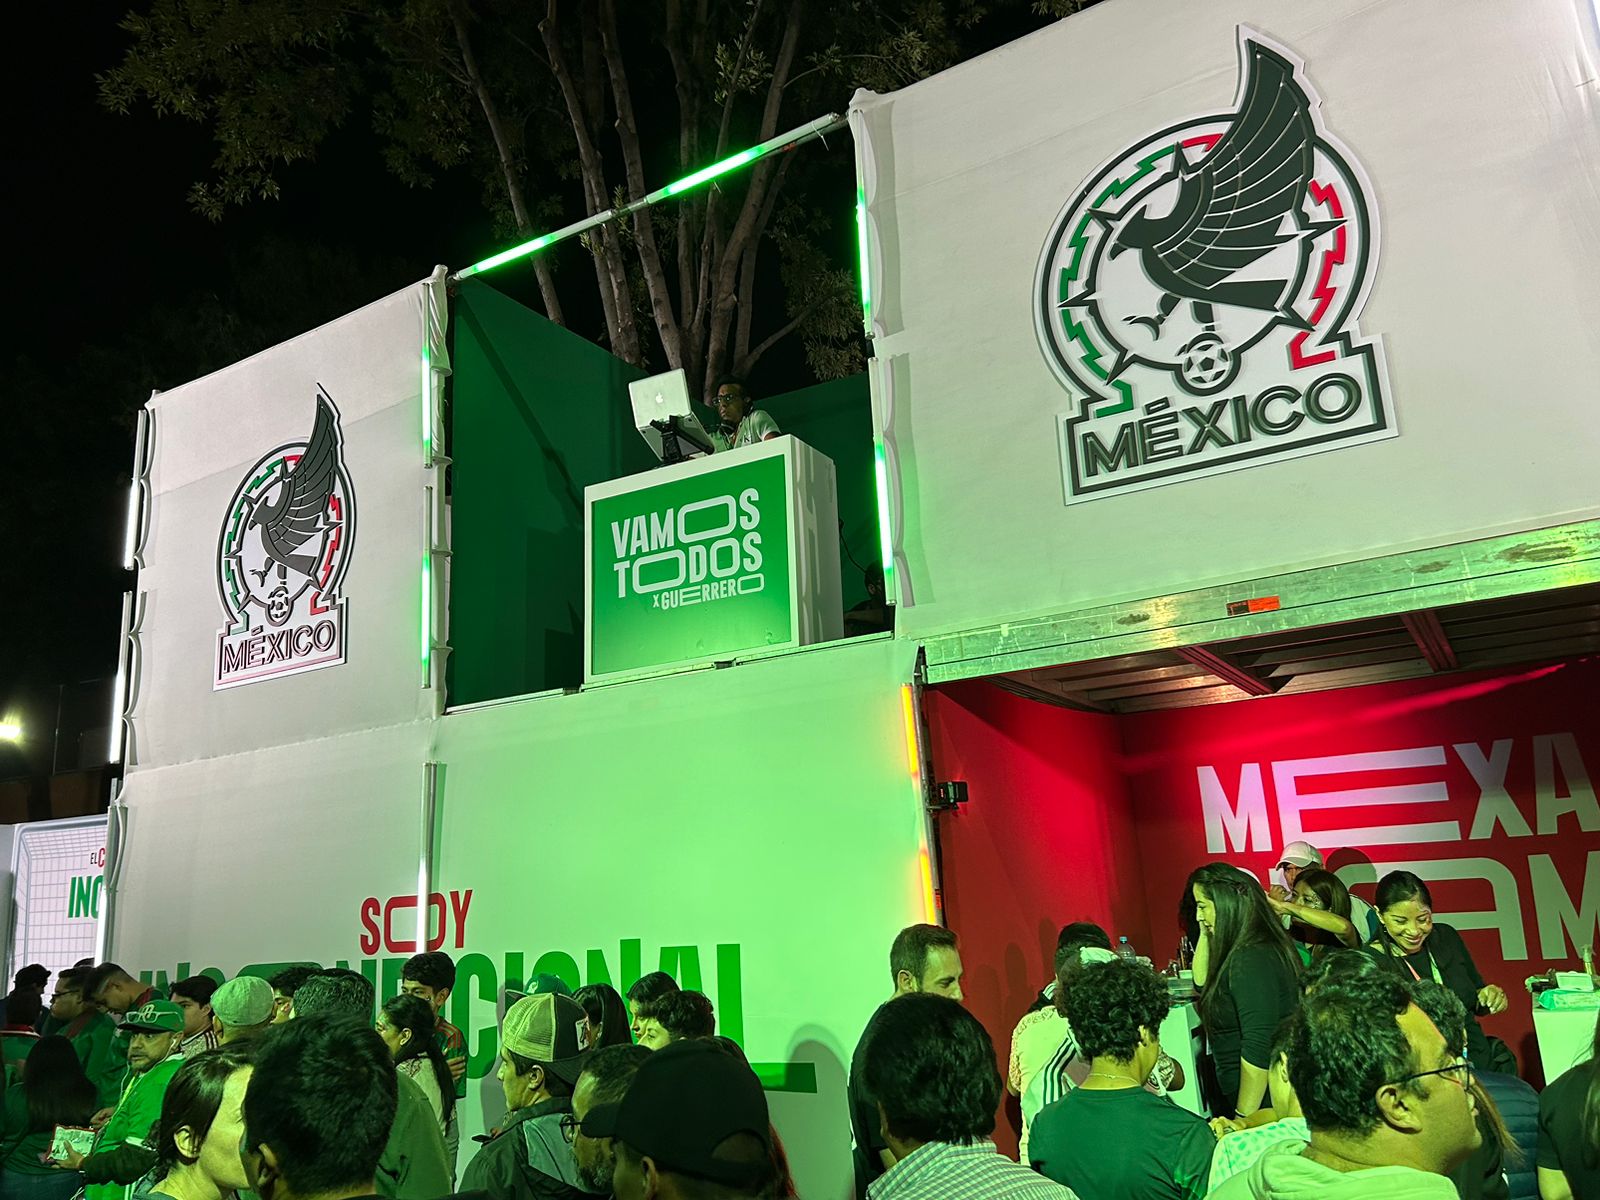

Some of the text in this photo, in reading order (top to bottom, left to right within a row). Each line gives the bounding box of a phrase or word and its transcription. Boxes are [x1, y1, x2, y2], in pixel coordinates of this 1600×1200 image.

[1081, 373, 1362, 477] MÉXICO
[611, 488, 760, 559] VAMOS
[613, 531, 763, 598] TODOS
[661, 573, 764, 610] GUERRERO
[223, 620, 336, 673] MÉXICO
[90, 852, 98, 865] EL
[360, 889, 473, 955] SOY
